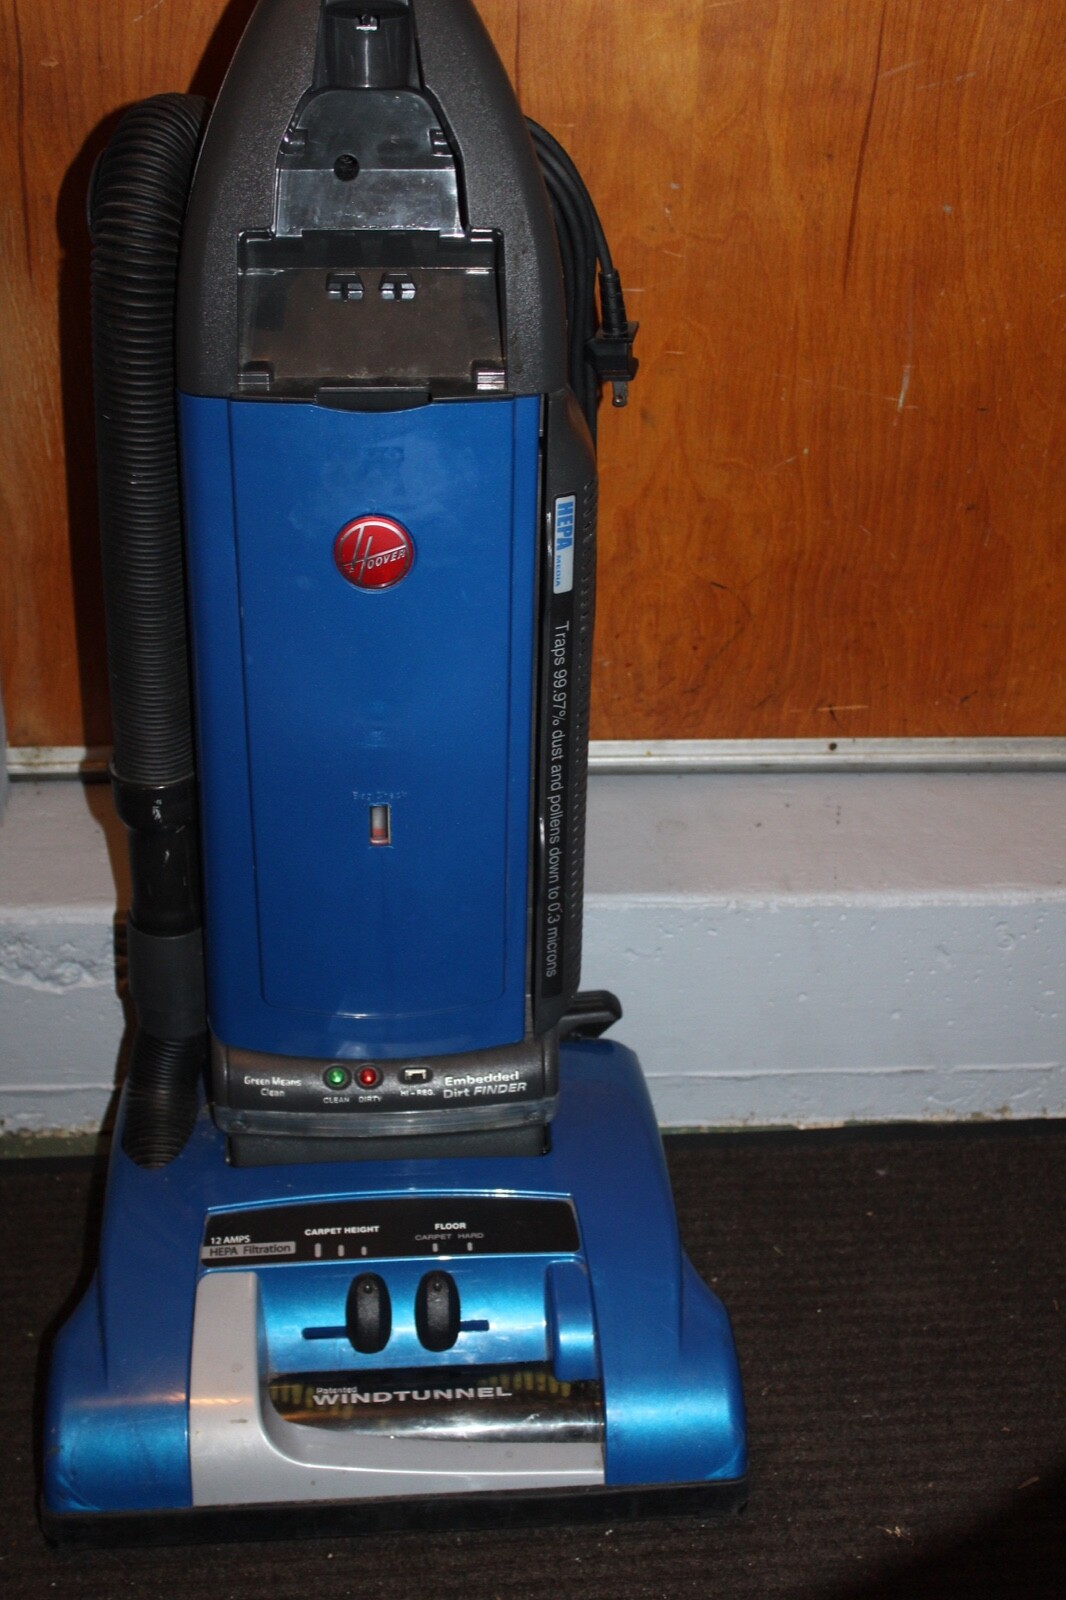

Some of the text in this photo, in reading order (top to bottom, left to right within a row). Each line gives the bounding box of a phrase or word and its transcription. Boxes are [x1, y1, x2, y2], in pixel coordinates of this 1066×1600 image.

[556, 501, 574, 551] HEPA
[546, 620, 570, 978] Traps 99.97% dust and pollens down to 0.3 microns
[244, 1075, 302, 1087] Green Means
[444, 1070, 520, 1087] Embedded
[260, 1088, 285, 1097] Clean
[443, 1082, 527, 1099] Dirt FINDER
[358, 1095, 382, 1103] DIRTY
[304, 1225, 380, 1236] CARPET HEIGHT
[434, 1222, 467, 1231] FLOOR
[210, 1235, 251, 1245] 12 AMPS
[414, 1233, 452, 1241] CARPET
[209, 1244, 291, 1257] HEPA Filtration
[316, 1386, 358, 1394] Patented
[312, 1386, 513, 1406] WINDTUNNEL
